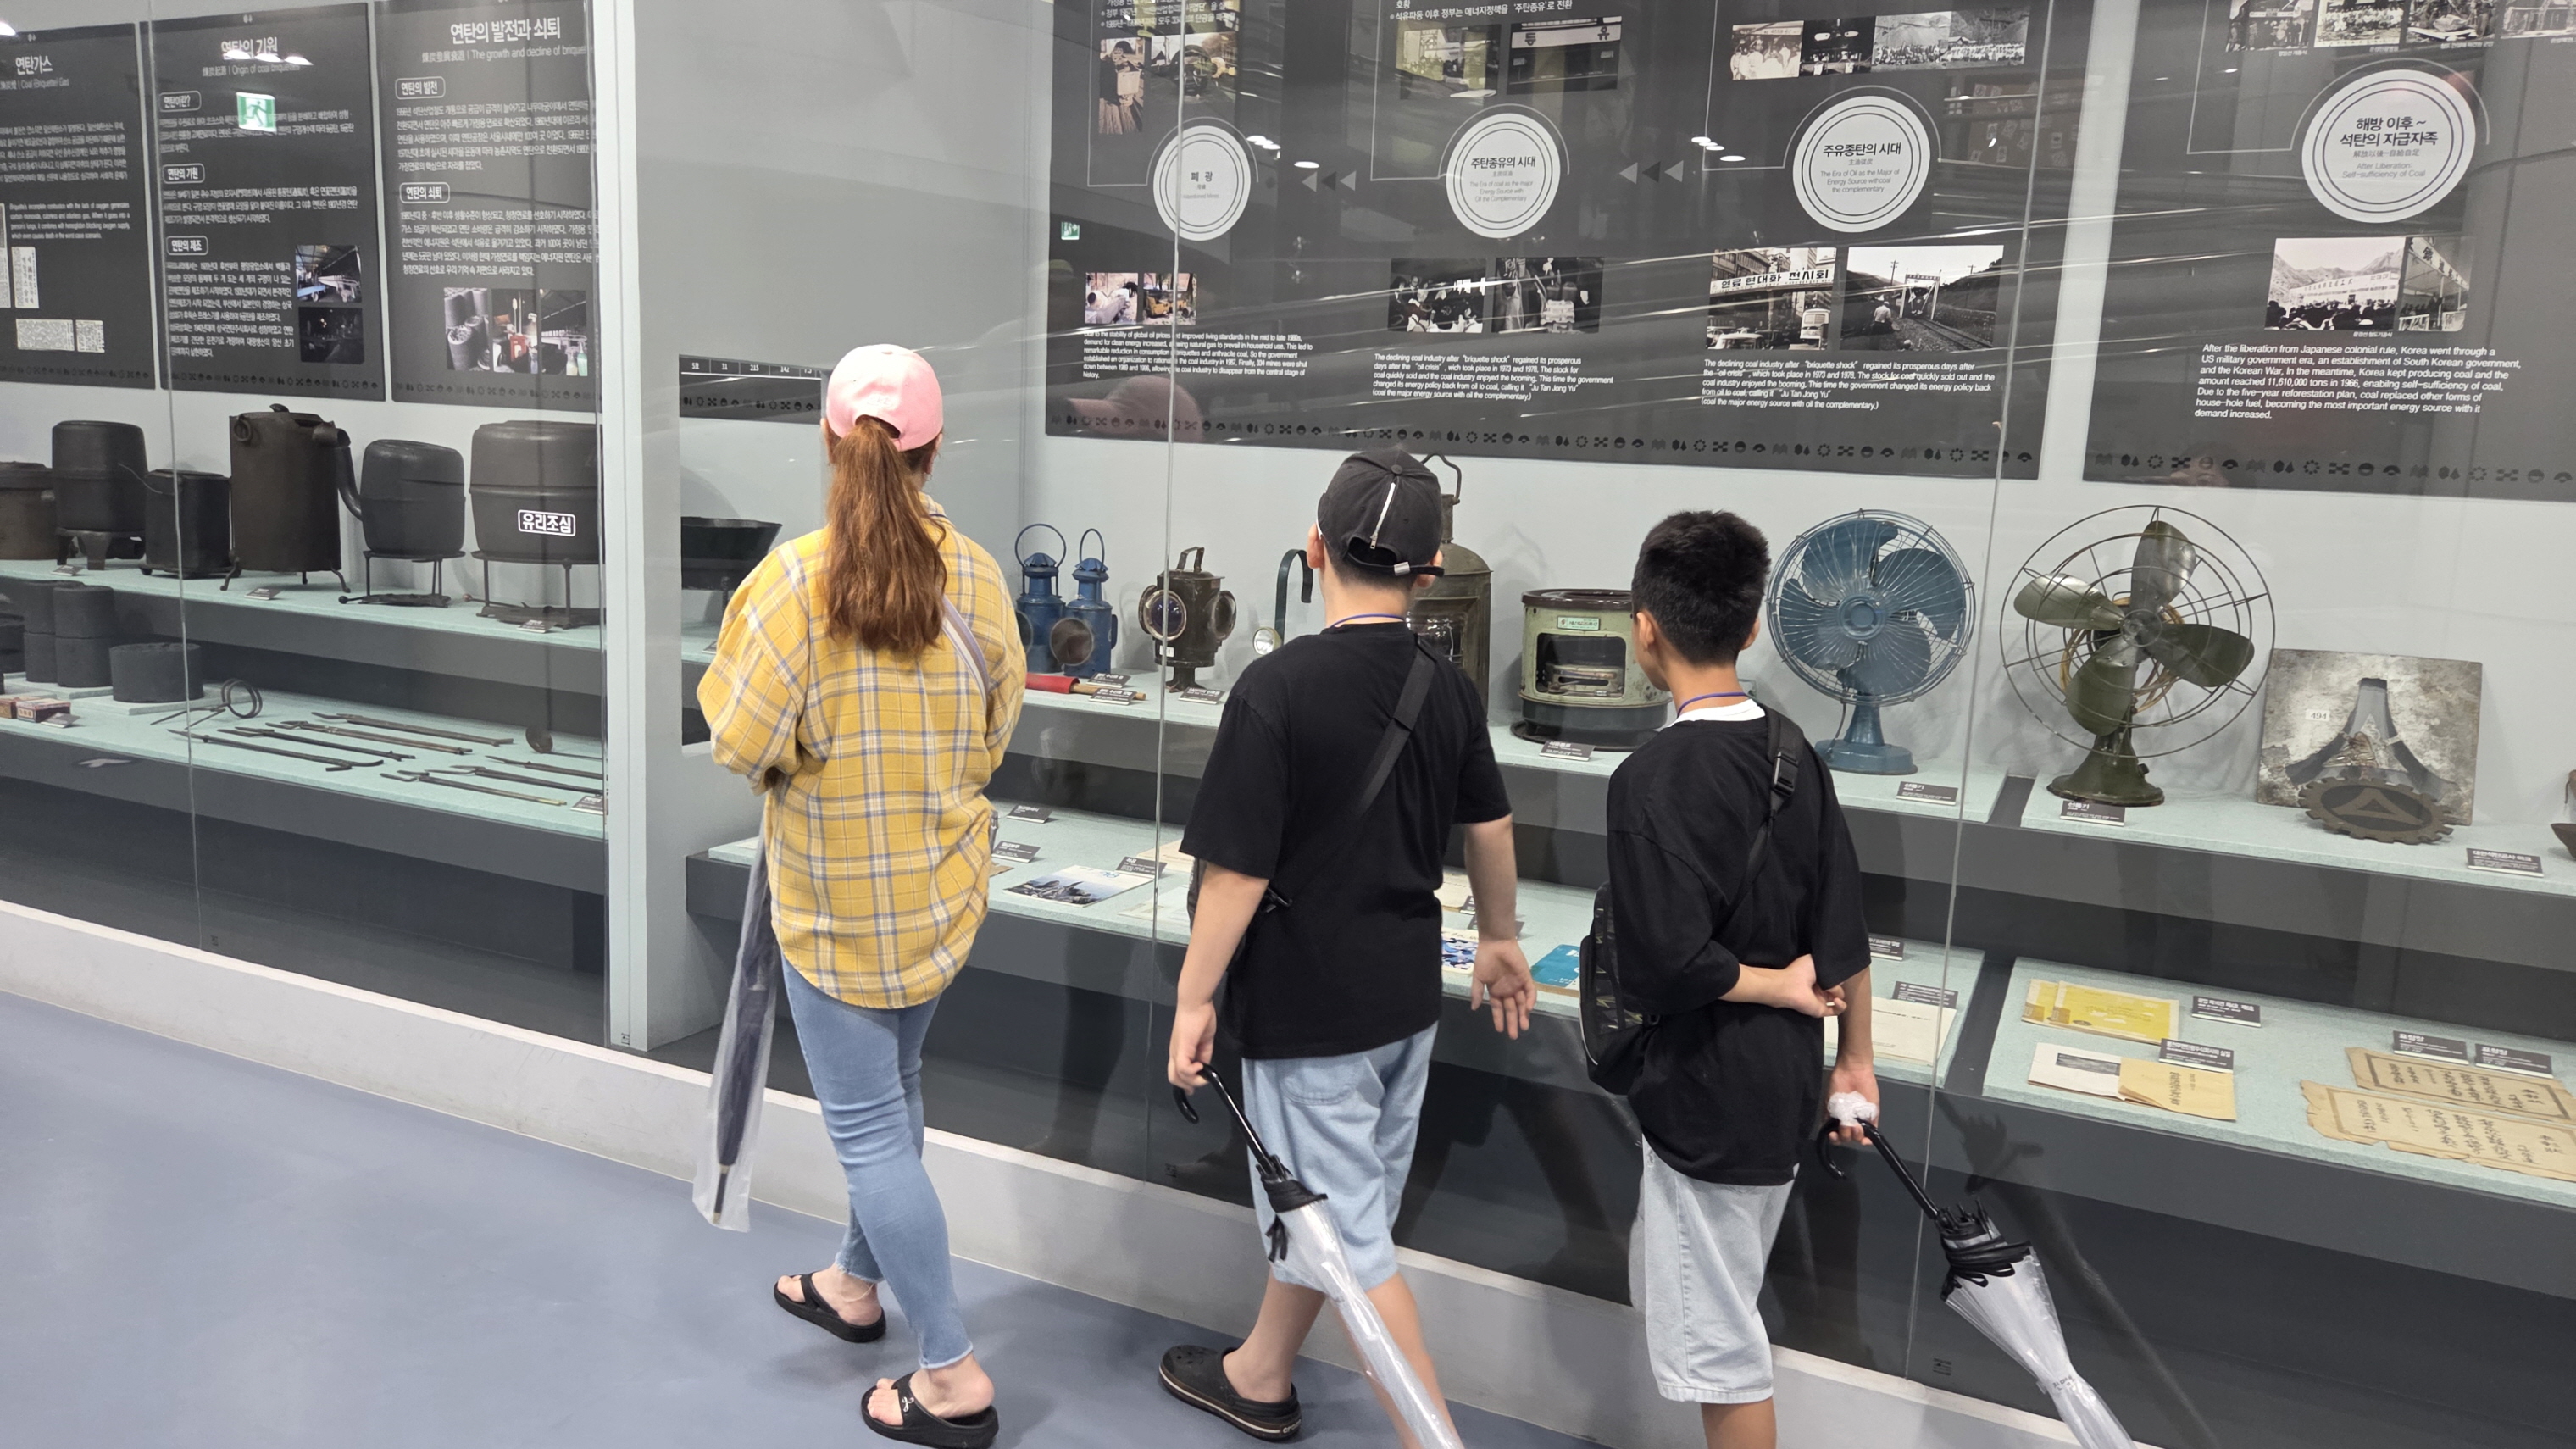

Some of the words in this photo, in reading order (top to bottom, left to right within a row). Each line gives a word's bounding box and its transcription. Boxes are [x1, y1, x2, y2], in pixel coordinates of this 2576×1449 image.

[1396, 10, 1424, 21] 석유파동
[1425, 10, 1440, 19] 이후
[1441, 8, 1463, 19] 정부는
[1464, 4, 1508, 17] 에너지정책을
[1557, 0, 1573, 10] 전환
[450, 22, 489, 45] 연탄의
[491, 19, 530, 42] 발전과
[533, 16, 561, 39] 쇠퇴
[1596, 25, 1610, 41] 유
[16, 55, 53, 75] 연탄가스
[401, 82, 423, 95] 연탄의
[423, 80, 438, 94] 발전
[2356, 117, 2384, 131] 해방
[2386, 116, 2414, 130] 이후
[2340, 133, 2380, 147] 석탄의
[2383, 131, 2439, 147] 자급자족
[1823, 143, 1877, 157] 주유종탄의
[1879, 142, 1901, 155] 시대
[1471, 157, 1516, 169] 주탄종유의
[1517, 156, 1536, 168] 시대
[406, 186, 426, 200] 연탄의
[428, 186, 442, 199] 쇠퇴
[2240, 344, 2277, 353] liberation
[2300, 345, 2342, 354] Japanese
[2379, 346, 2398, 354] rule,
[2401, 346, 2427, 354] Korea
[2453, 347, 2487, 357] through
[1717, 359, 1744, 369] declining
[1759, 361, 1784, 369] industry
[1863, 362, 1891, 370] regained
[1940, 363, 1957, 371] days
[2201, 354, 2214, 363] US
[2216, 355, 2246, 364] military
[2392, 357, 2401, 365] of
[2403, 357, 2429, 365] South
[2431, 358, 2463, 366] Korean
[2312, 368, 2356, 376] meantime,
[2359, 368, 2384, 376] Korea
[2387, 369, 2407, 378] kept
[2407, 369, 2451, 379] producing
[522, 513, 573, 535] 유리조심
